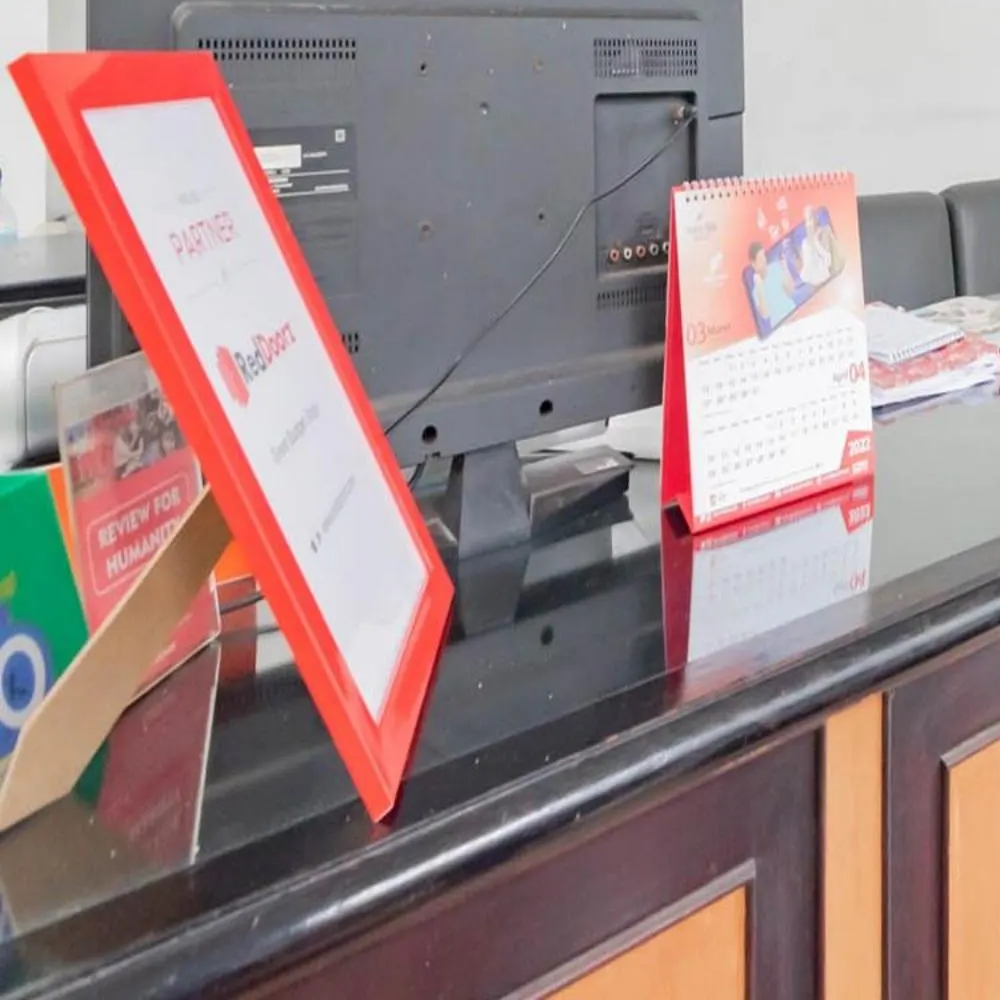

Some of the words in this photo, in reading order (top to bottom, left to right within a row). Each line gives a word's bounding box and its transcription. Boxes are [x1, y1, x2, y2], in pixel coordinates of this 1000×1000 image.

[168, 210, 240, 265] PARTNER
[686, 320, 707, 348] 03
[848, 360, 867, 384] 04
[98, 499, 151, 550] REVIEW
[152, 485, 181, 518] FOR
